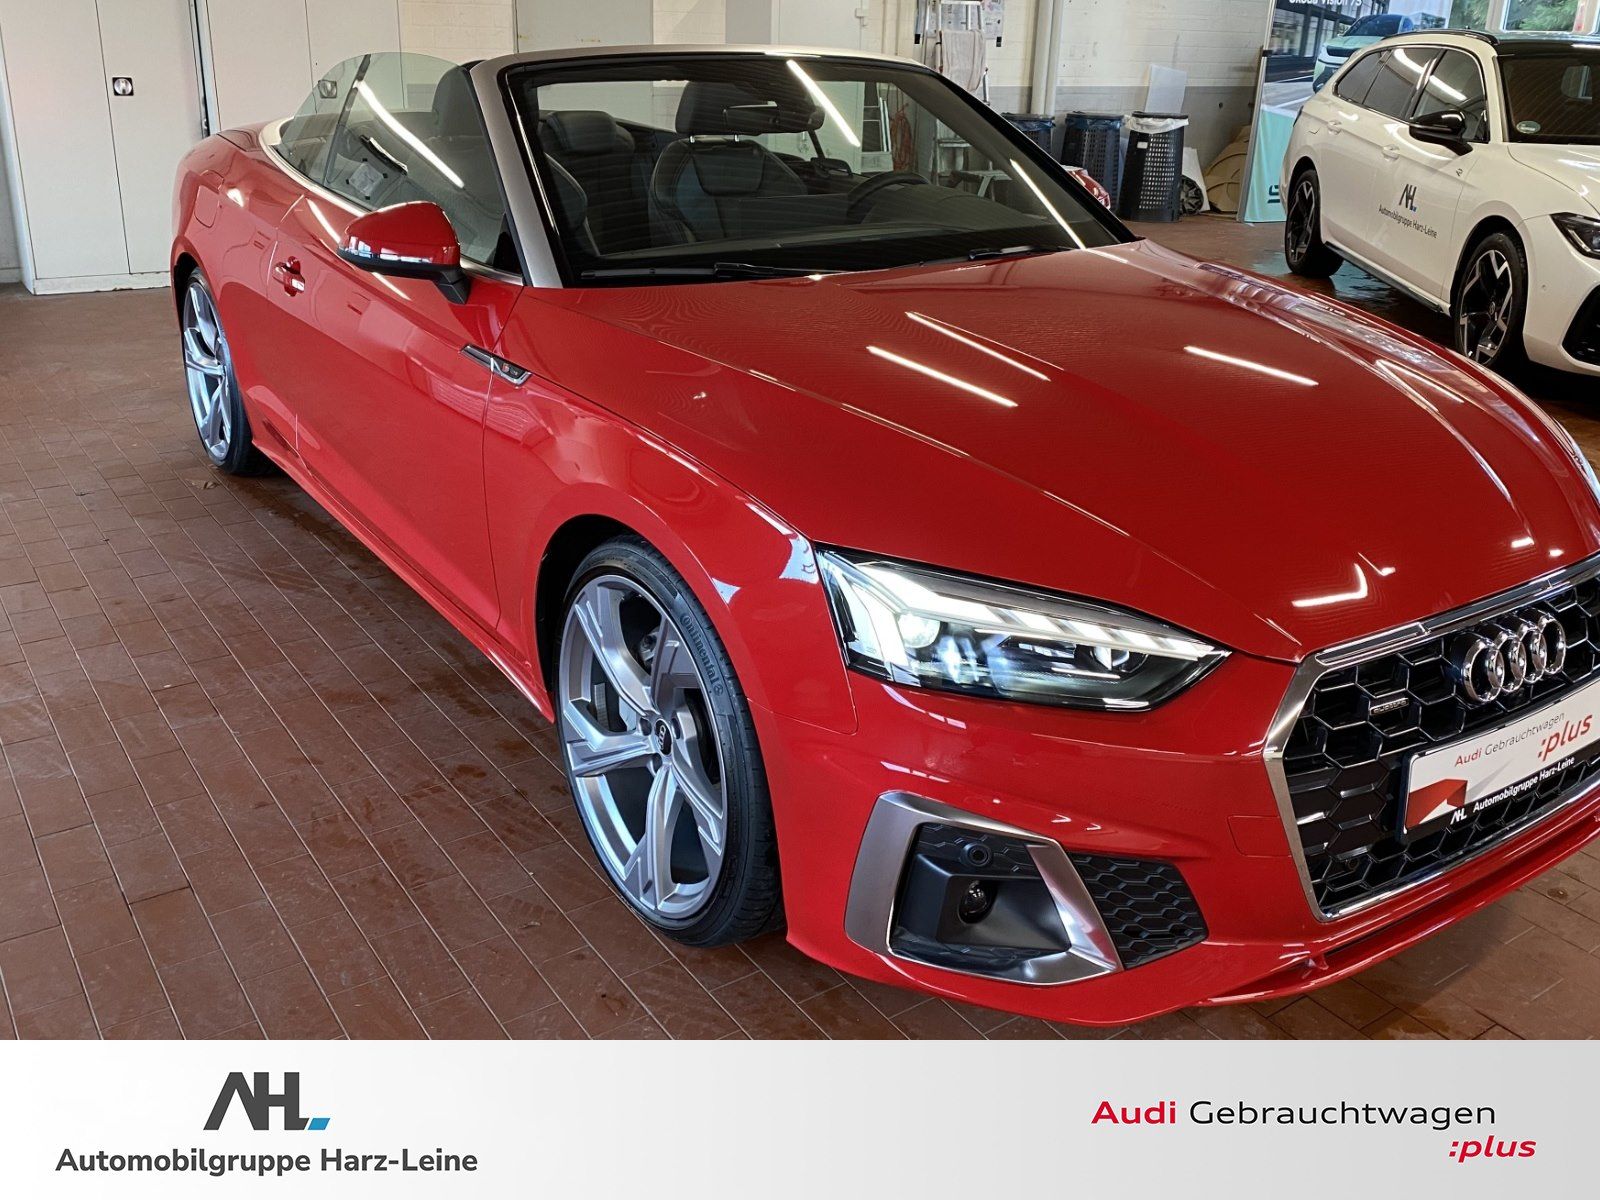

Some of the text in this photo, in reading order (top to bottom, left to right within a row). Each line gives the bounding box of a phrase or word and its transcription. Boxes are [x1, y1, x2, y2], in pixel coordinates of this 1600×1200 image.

[1379, 204, 1437, 239] Automobilgruppe Harz-Leine
[680, 613, 720, 685] Continental
[1454, 712, 1565, 767] Audi Gebrauchtwagen
[1537, 714, 1593, 762] :plus
[1472, 775, 1538, 813] Automobilgruppe
[1539, 756, 1576, 780] Harz-Leine
